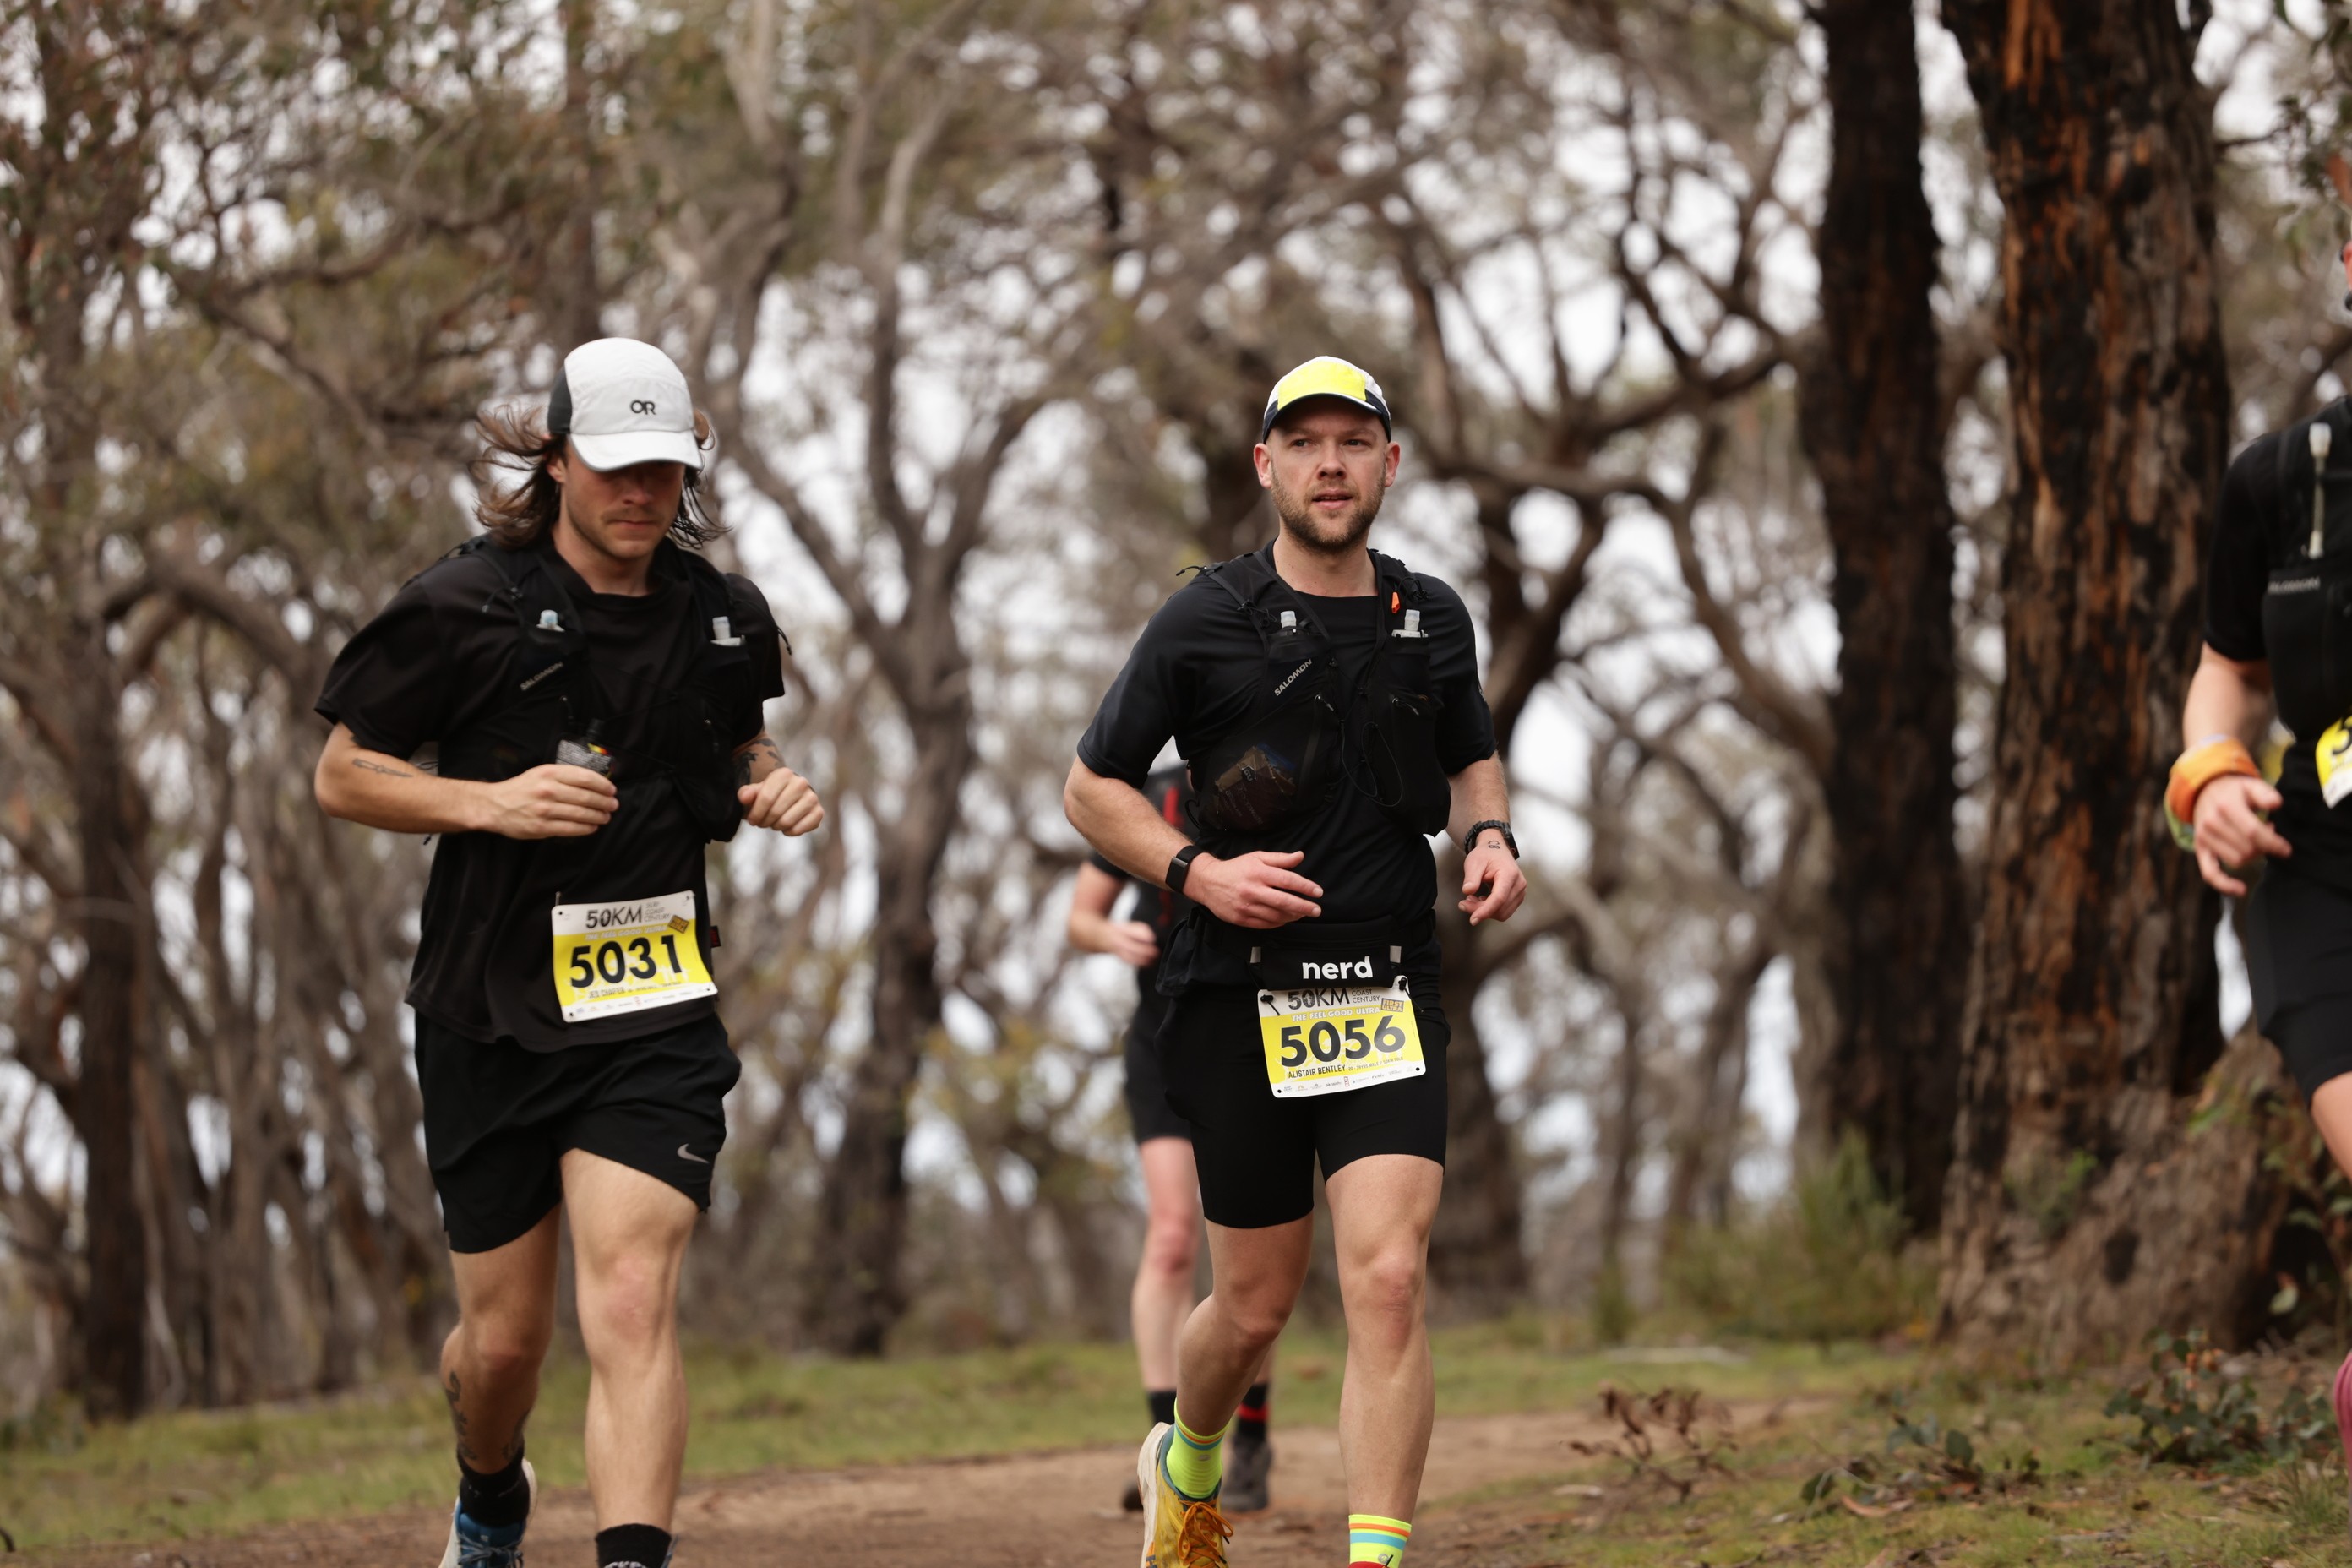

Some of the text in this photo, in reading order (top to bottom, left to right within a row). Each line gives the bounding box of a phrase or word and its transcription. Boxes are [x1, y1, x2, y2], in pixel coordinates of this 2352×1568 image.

[1274, 659, 1313, 696] SALOMON
[1244, 769, 1254, 781] GU
[586, 904, 642, 928] 50KM
[570, 934, 682, 988] 5031
[1302, 956, 1373, 980] nerd
[1288, 987, 1350, 1010] 50KM
[1353, 995, 1380, 1004] CENTURY
[1328, 1009, 1353, 1017] GOOD
[1356, 1006, 1380, 1015] ULTRA
[1281, 1015, 1406, 1067] 5056
[1288, 1068, 1315, 1079] ALISTAIR
[1318, 1064, 1346, 1075] BENTLEY
